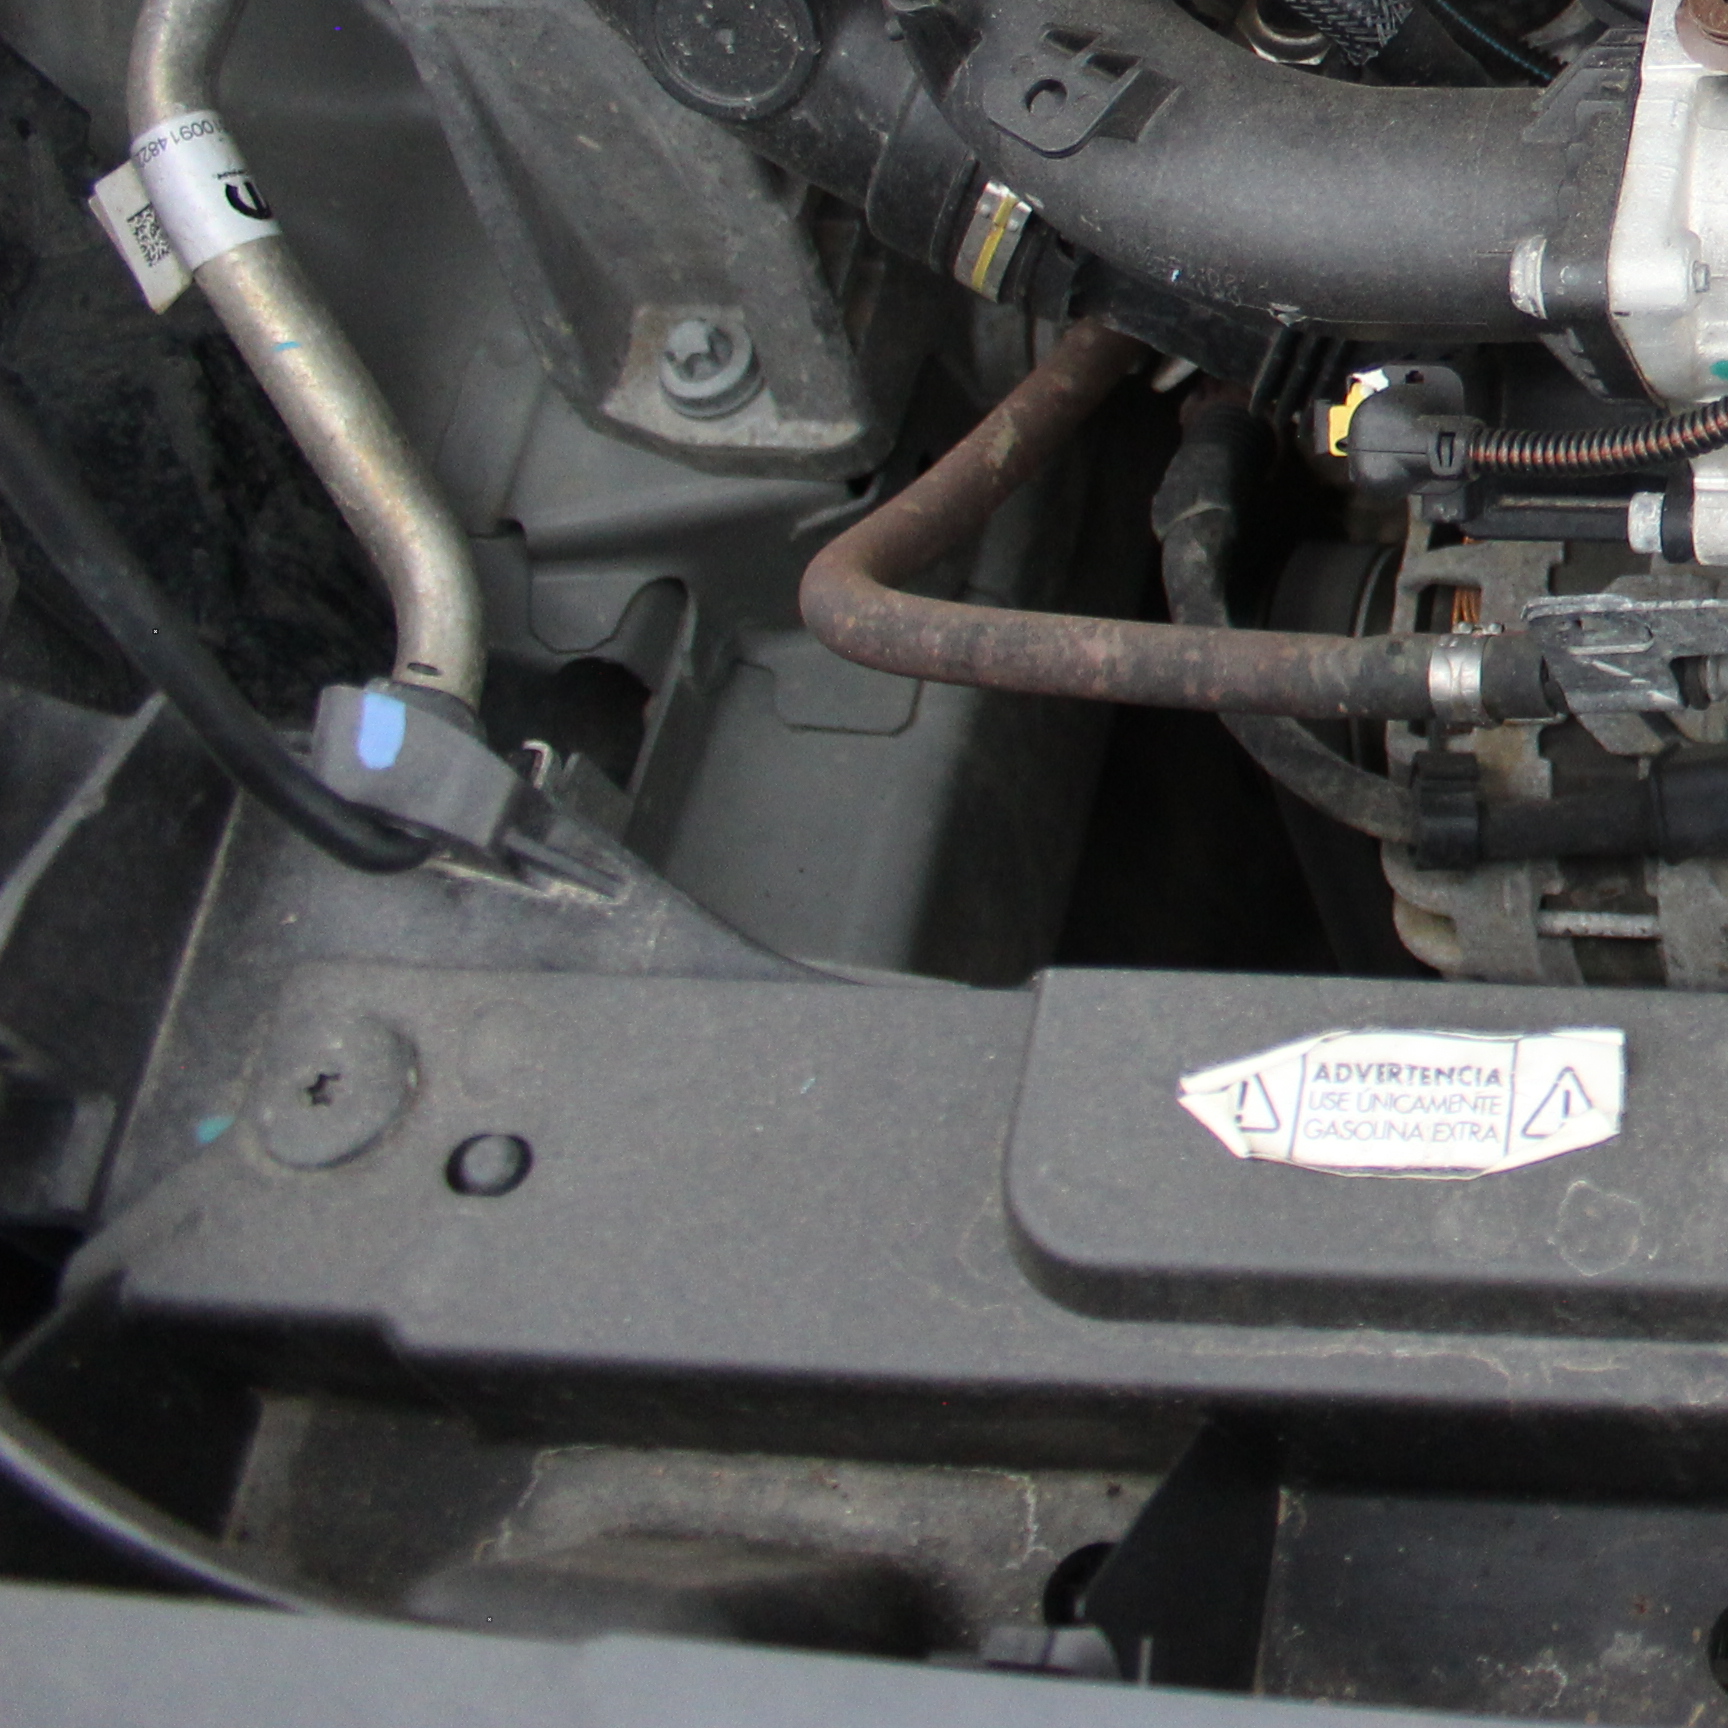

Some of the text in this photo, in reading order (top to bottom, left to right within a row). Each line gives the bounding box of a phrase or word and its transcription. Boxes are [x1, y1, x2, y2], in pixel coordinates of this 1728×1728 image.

[1311, 1061, 1503, 1088] ADVERTENCIA
[1308, 1087, 1504, 1116] USE ÚNICAMENTE
[1303, 1117, 1501, 1144] GASOLINA EXTRA
